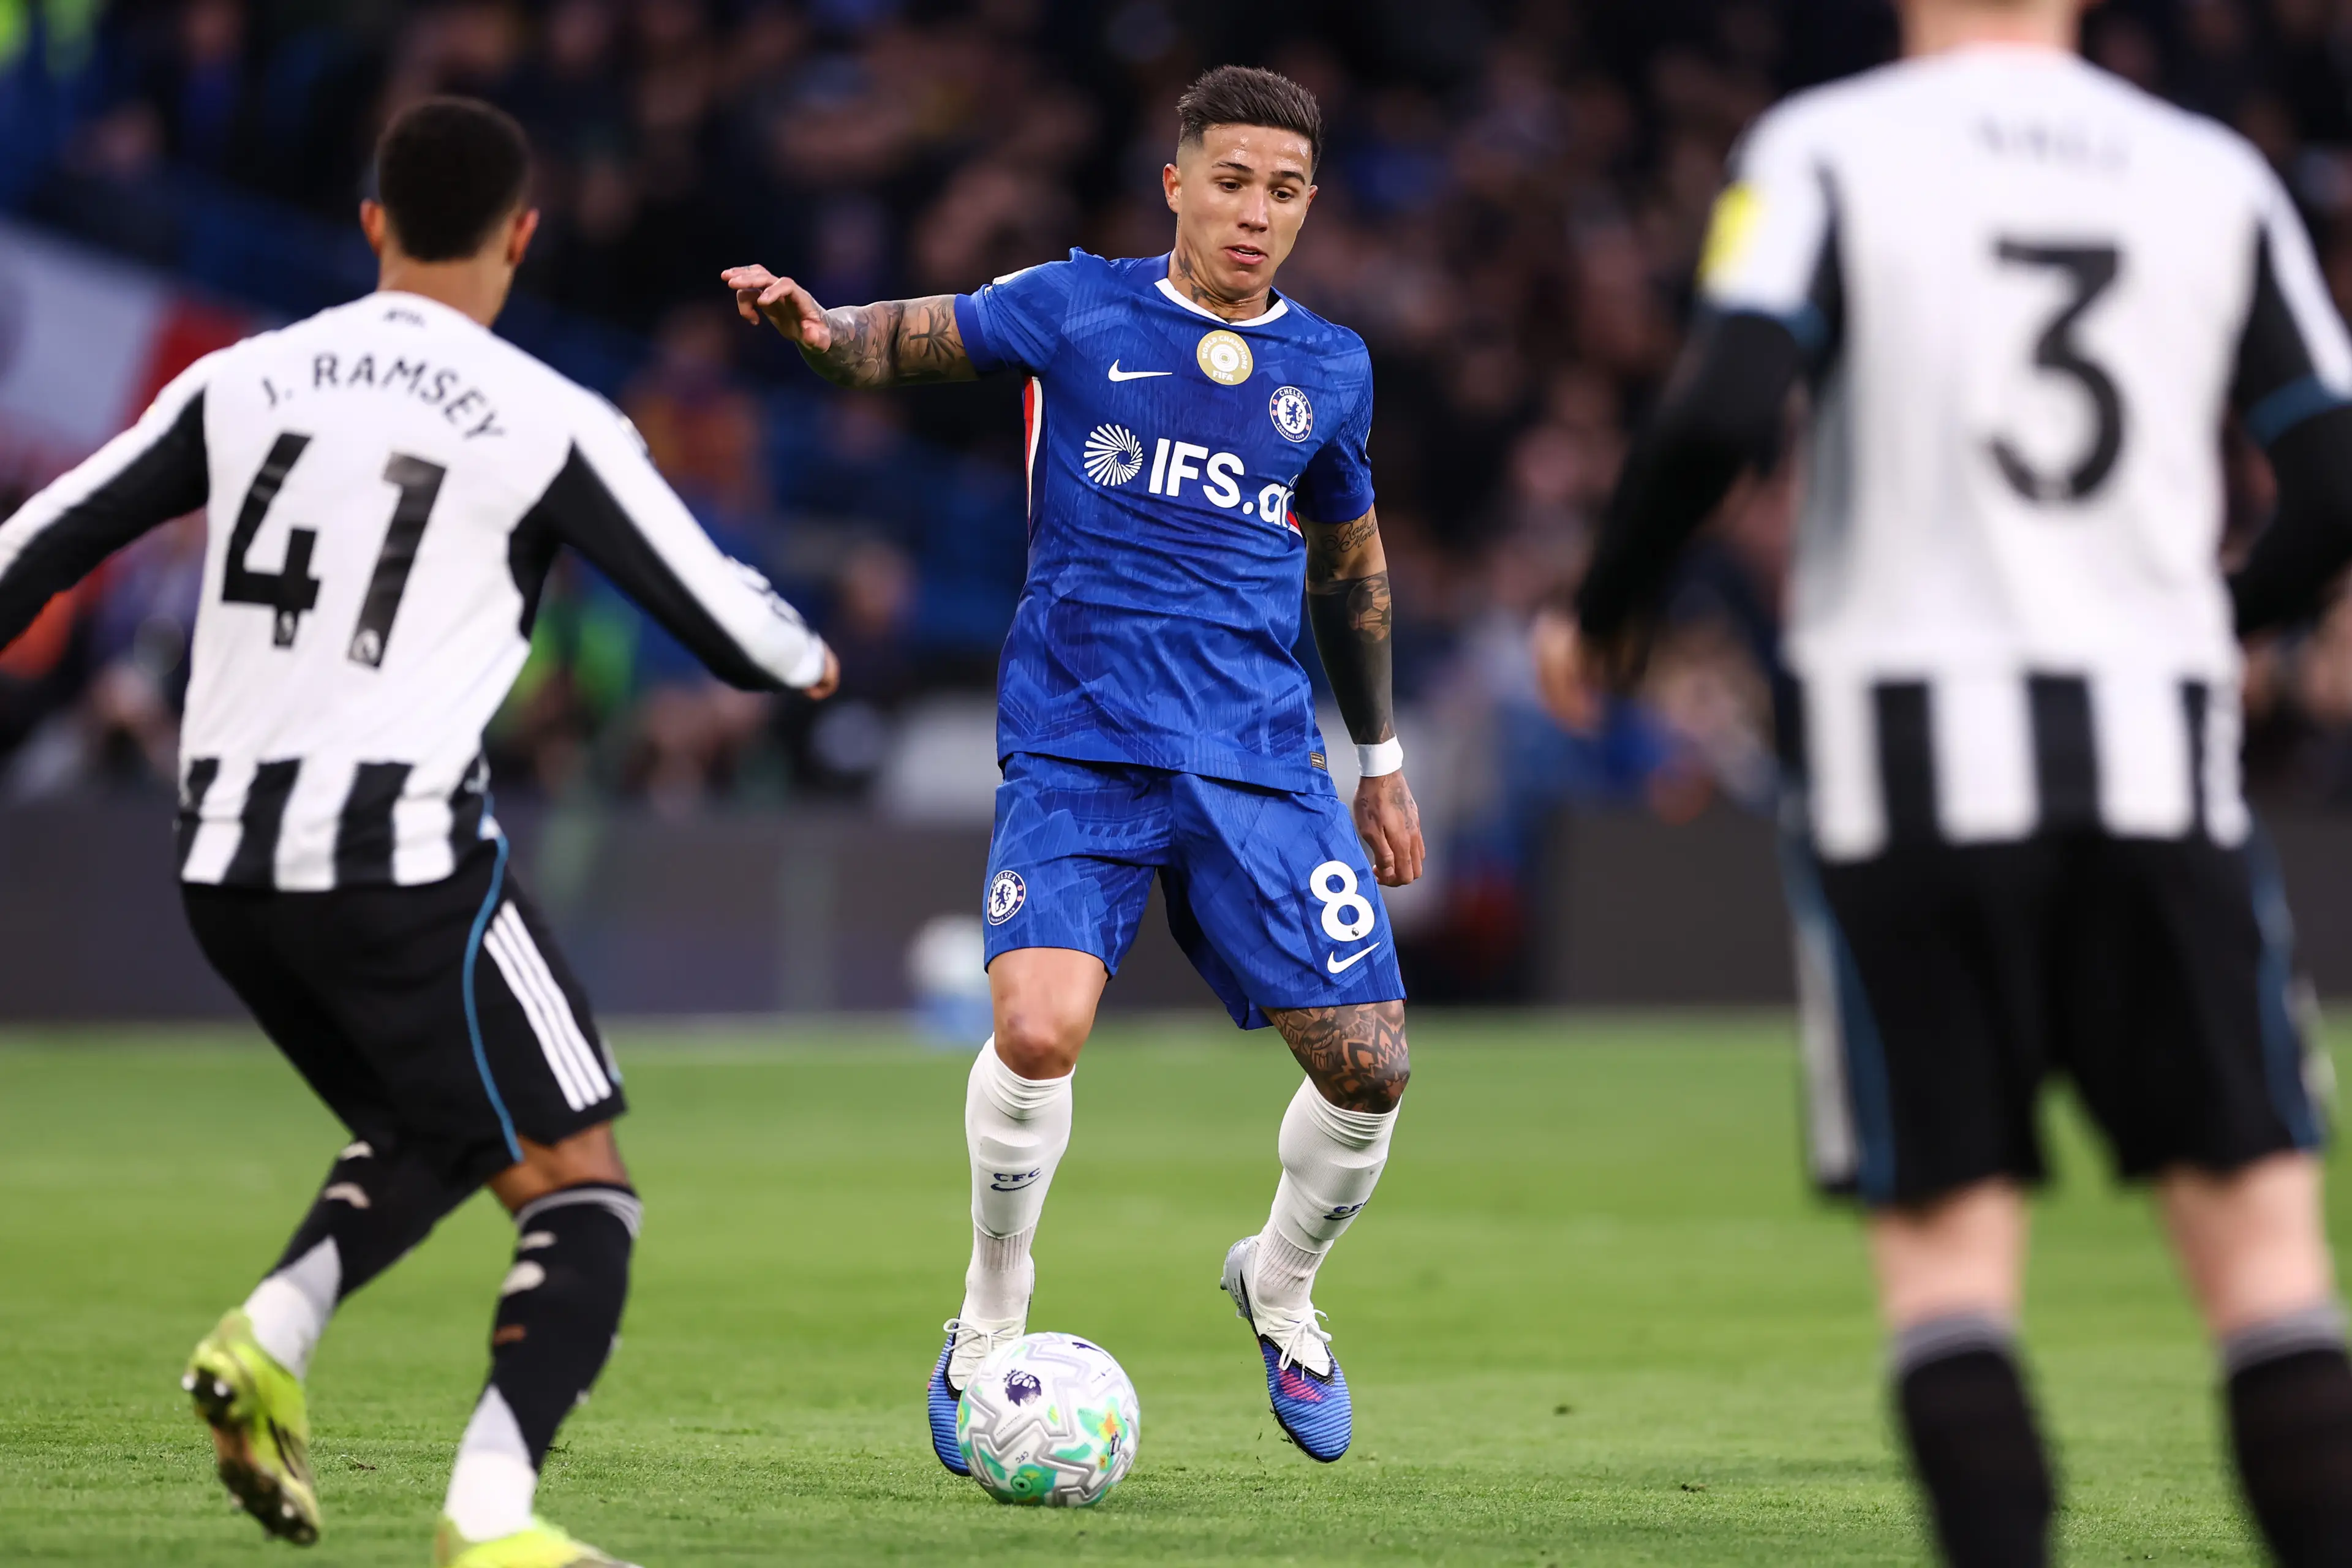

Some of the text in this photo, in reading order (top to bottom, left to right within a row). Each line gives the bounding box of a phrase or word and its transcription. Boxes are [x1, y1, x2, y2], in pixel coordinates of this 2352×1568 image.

[1202, 335, 1248, 370] WORLD CHAMPIONS
[1213, 370, 1234, 382] FIFA
[1985, 233, 2128, 502] 3
[260, 352, 507, 440] J. RAMSEY
[1279, 388, 1306, 406] CHELSEA
[1277, 423, 1294, 439] FOOTBALL
[221, 431, 447, 671] 41
[992, 872, 1016, 890] CHELSEA
[1309, 860, 1374, 943] 8
[1005, 907, 1016, 917] CLUB
[993, 1167, 1041, 1182] CFC
